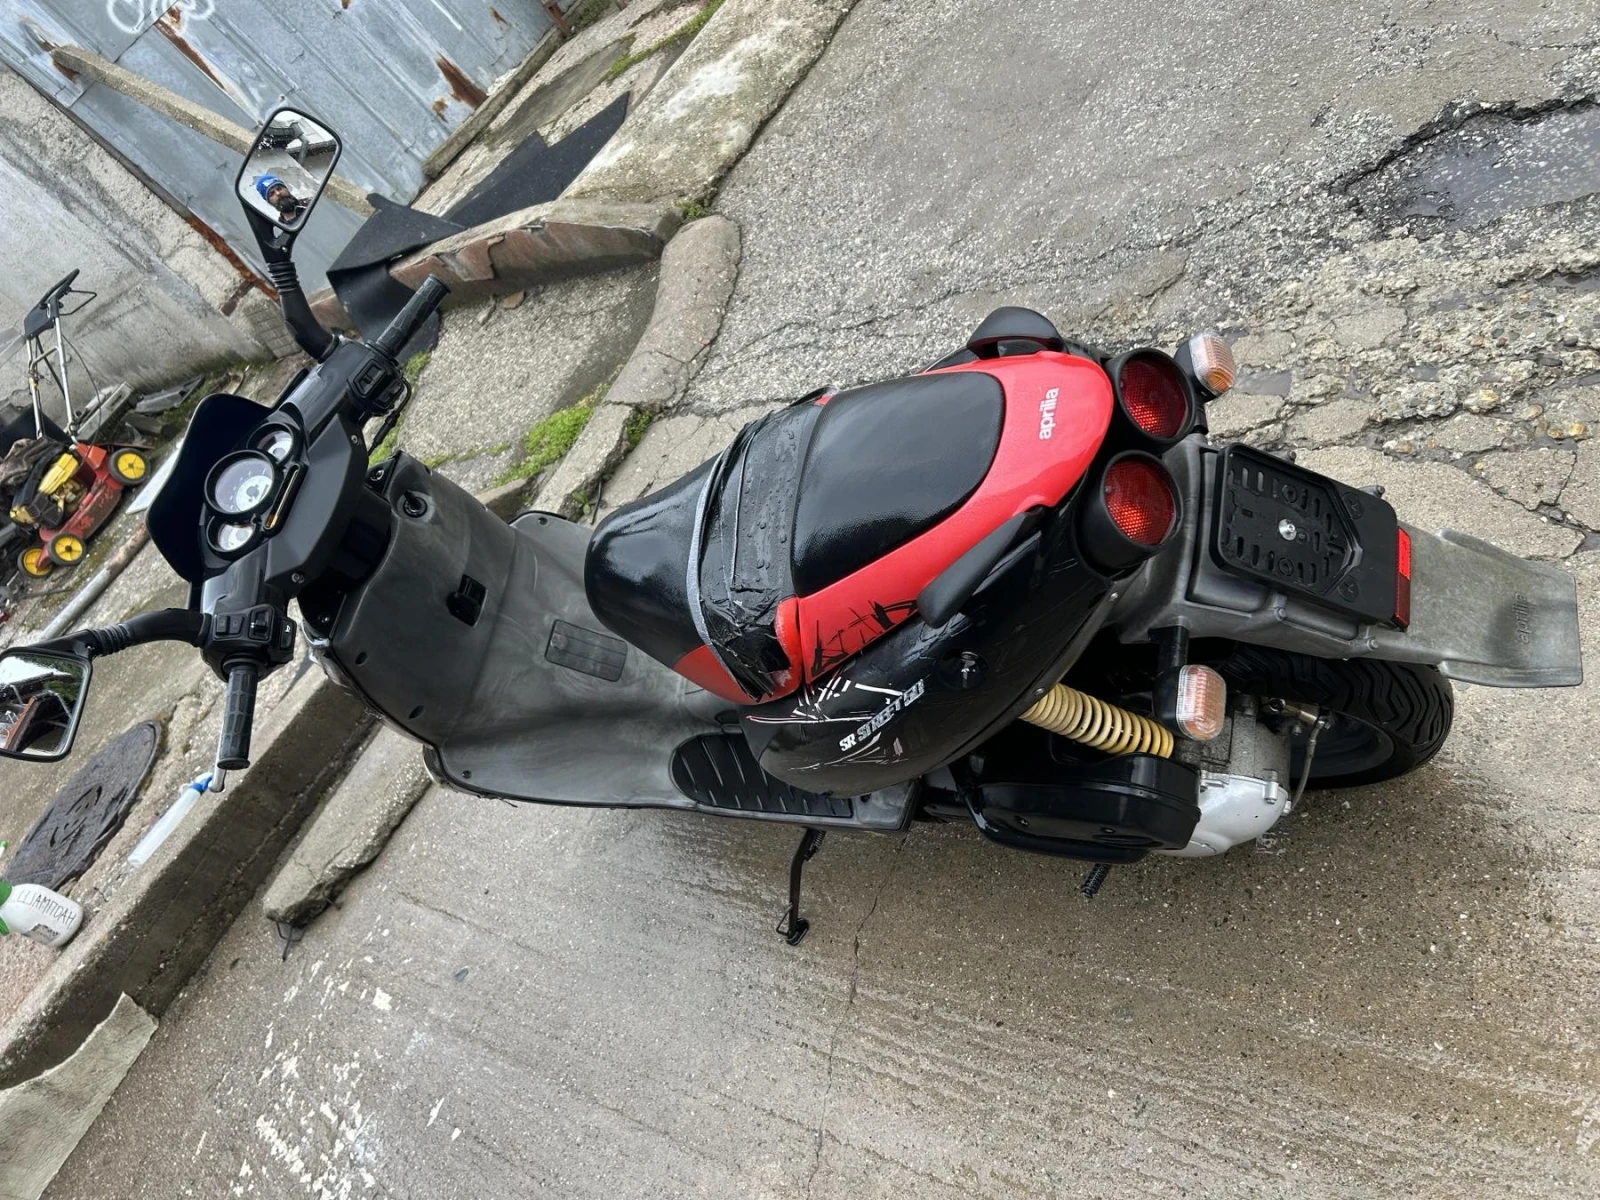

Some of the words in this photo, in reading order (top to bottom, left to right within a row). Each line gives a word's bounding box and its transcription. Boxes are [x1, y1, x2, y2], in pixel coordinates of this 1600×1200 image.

[1038, 387, 1060, 441] aprilia
[839, 732, 857, 752] SR
[856, 697, 903, 742] STREET
[903, 678, 925, 708] 50
